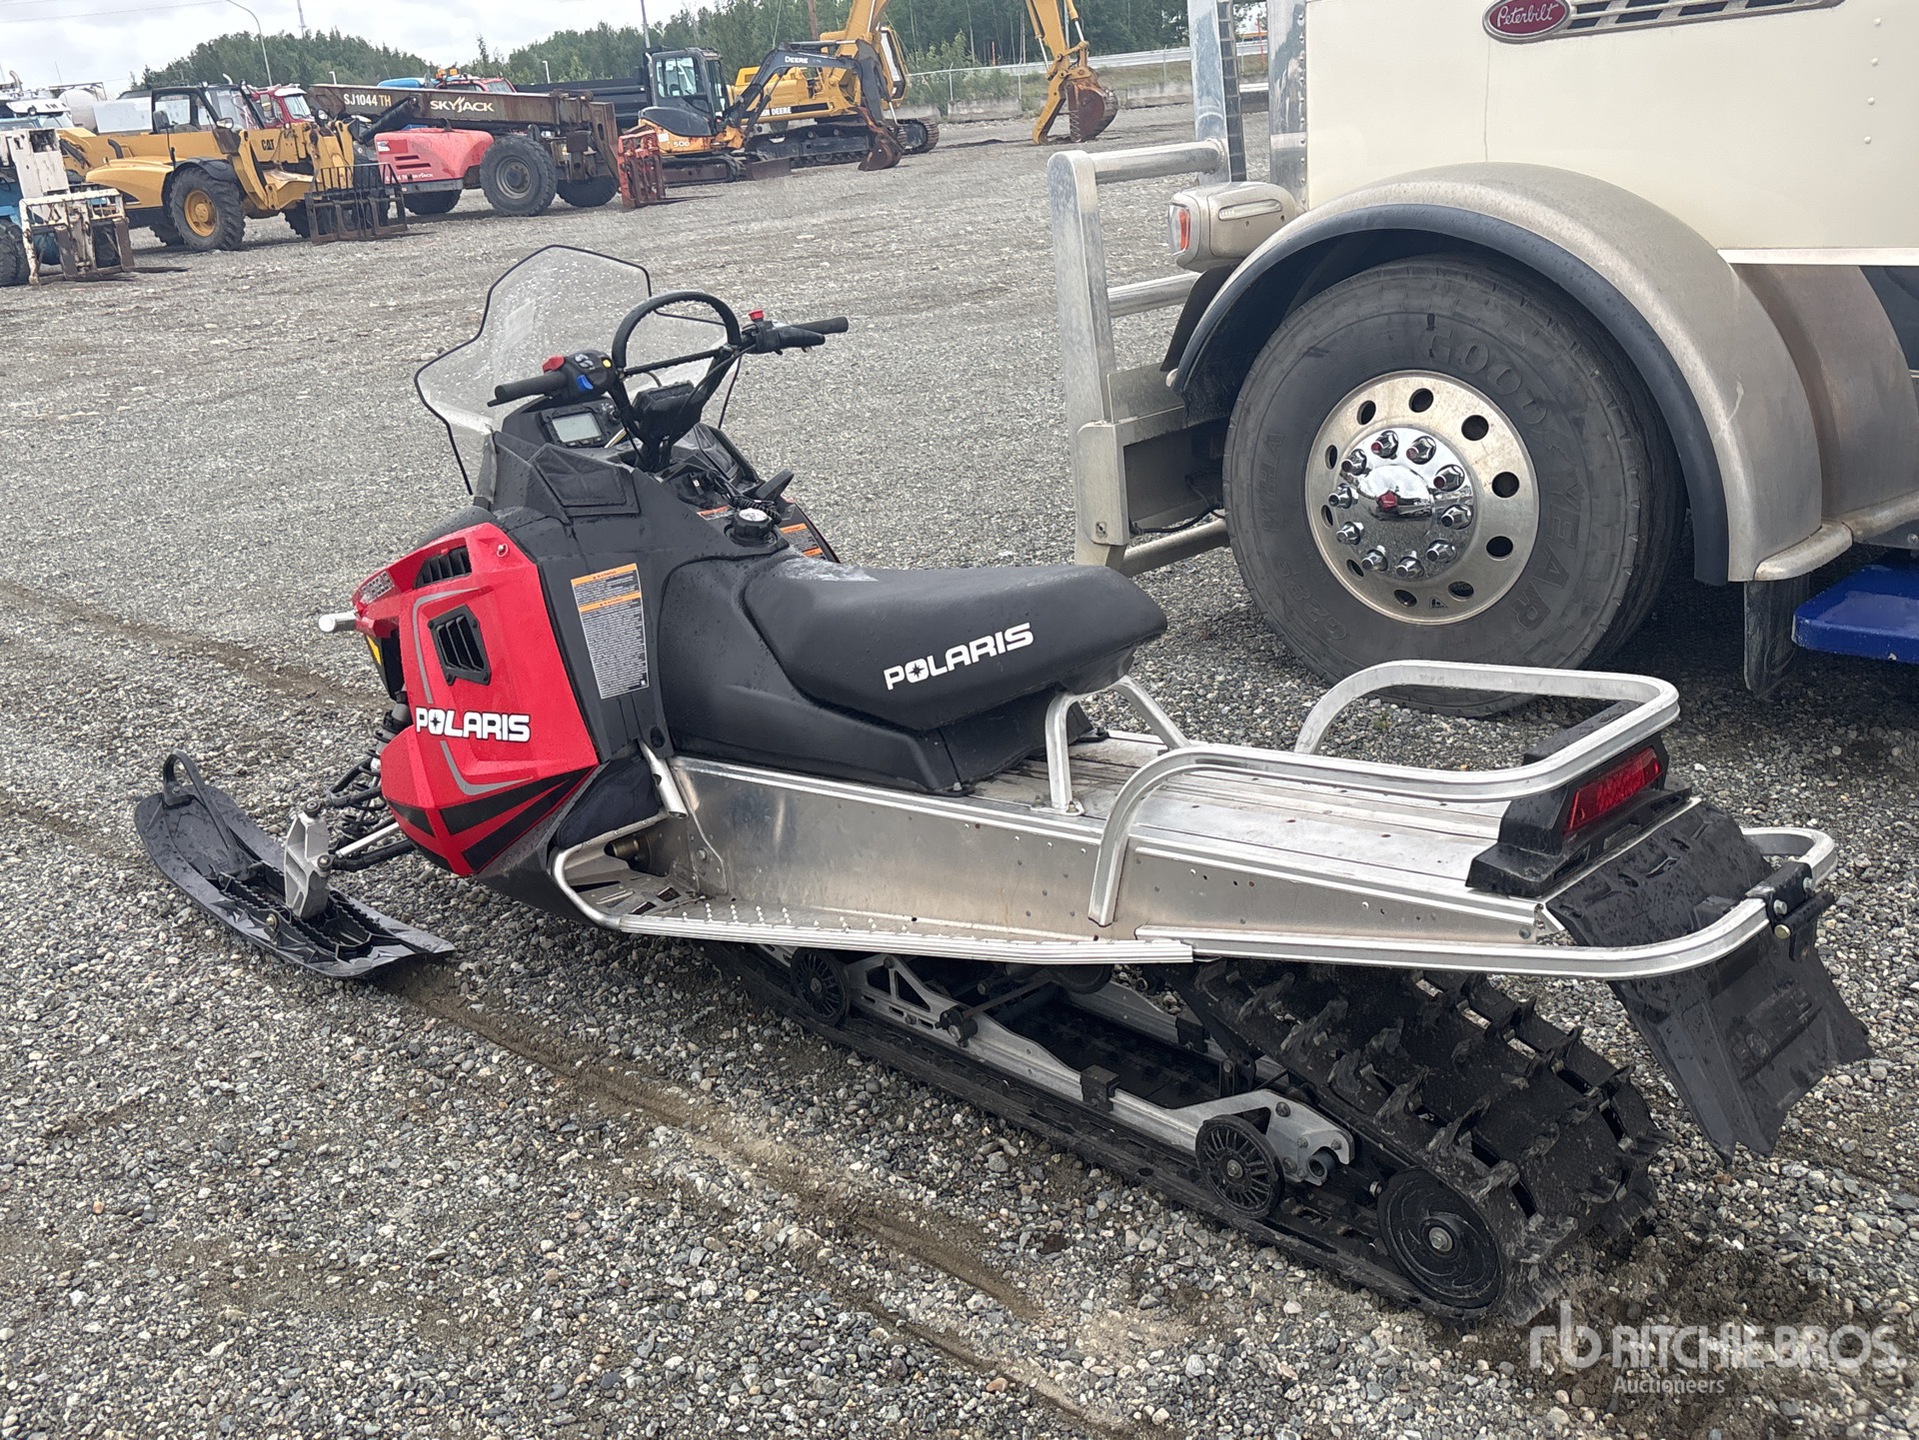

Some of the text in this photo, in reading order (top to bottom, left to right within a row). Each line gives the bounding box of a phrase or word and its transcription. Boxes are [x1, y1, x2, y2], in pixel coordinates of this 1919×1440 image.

[1497, 3, 1559, 28] Peterbilt
[784, 55, 809, 64] DEERE
[343, 93, 392, 107] SJ1044 TH
[429, 96, 495, 113] SKYJACK
[771, 106, 792, 116] DEERE
[261, 139, 275, 151] CAT
[883, 622, 1034, 690] POLARIS
[415, 706, 531, 742] POLARIS
